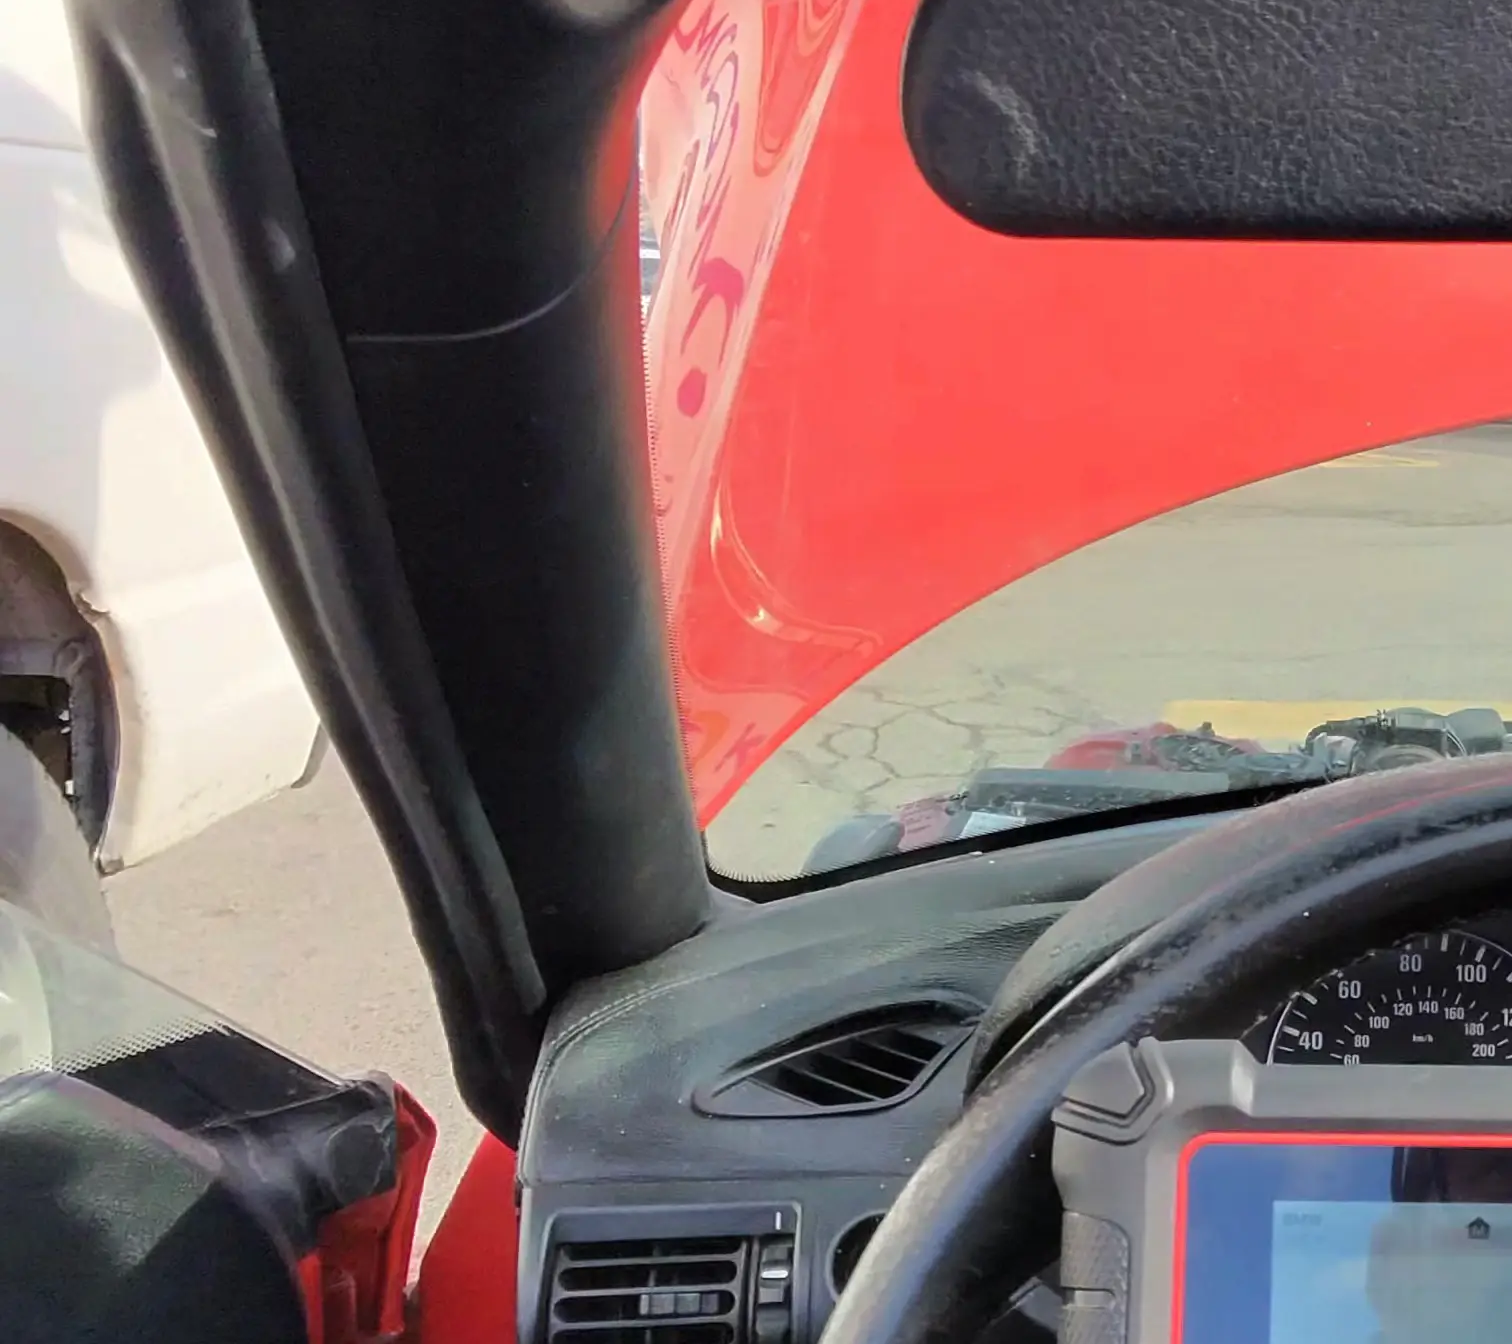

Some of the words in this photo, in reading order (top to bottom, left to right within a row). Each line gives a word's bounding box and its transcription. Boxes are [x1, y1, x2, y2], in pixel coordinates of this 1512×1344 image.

[1400, 954, 1422, 973] 80
[1456, 964, 1487, 983] 100
[1338, 980, 1361, 999] 60
[1393, 1003, 1412, 1017] 120
[1418, 1001, 1438, 1015] 140
[1444, 1006, 1464, 1020] 160
[1369, 1016, 1390, 1030] 100
[1464, 1022, 1485, 1036] 180
[1298, 1031, 1323, 1051] 40
[1354, 1034, 1370, 1048] 80
[1472, 1043, 1496, 1057] 200
